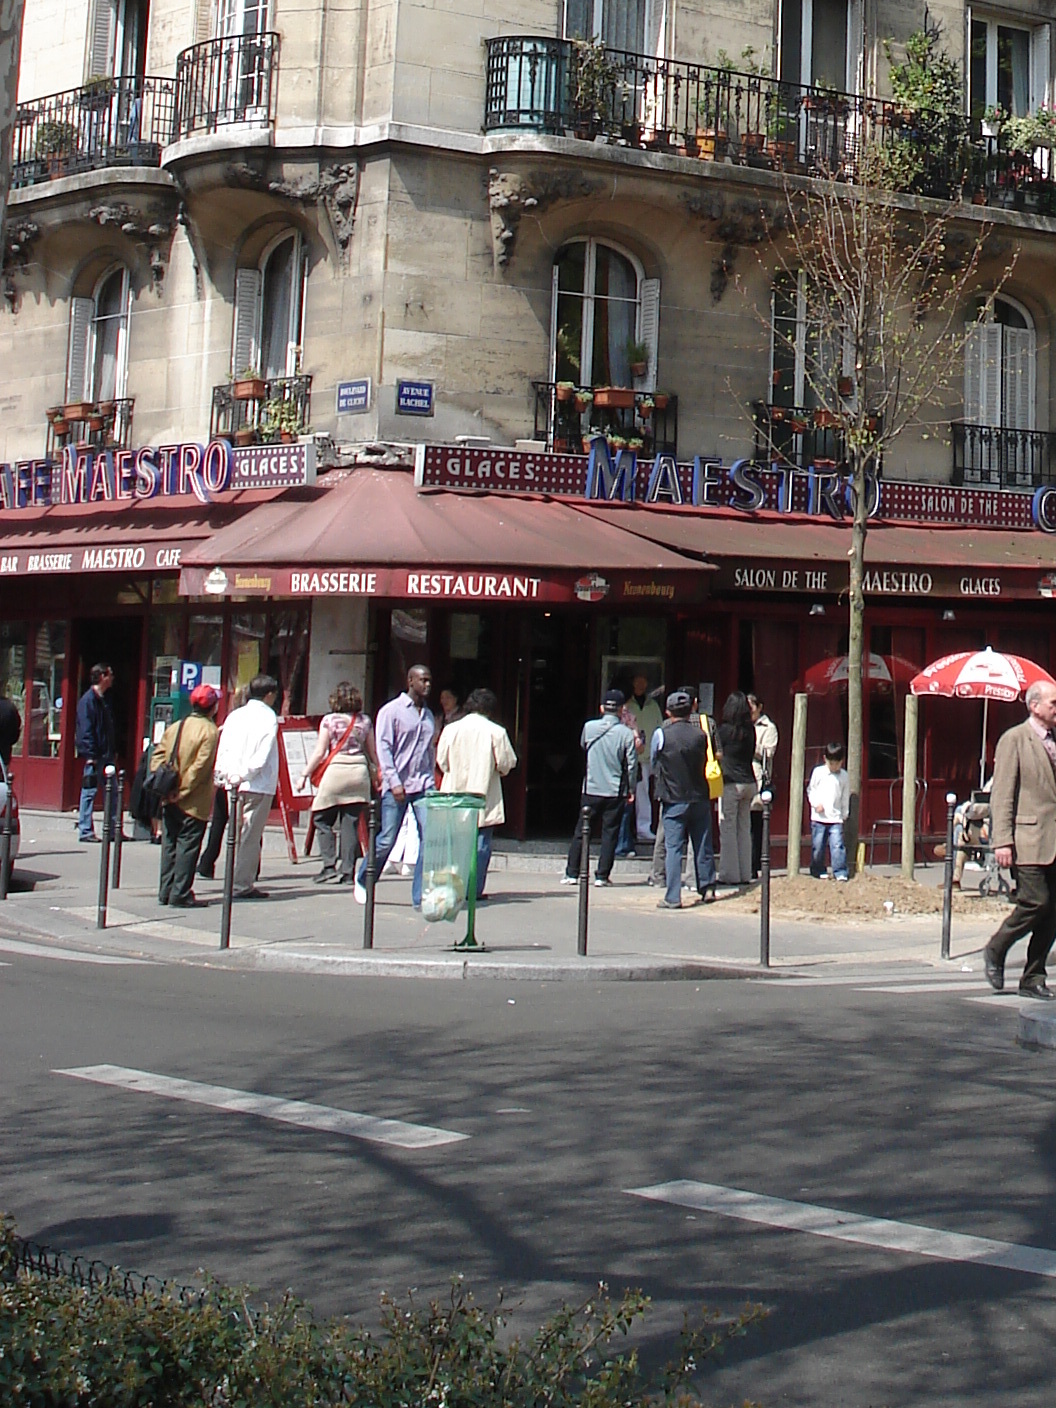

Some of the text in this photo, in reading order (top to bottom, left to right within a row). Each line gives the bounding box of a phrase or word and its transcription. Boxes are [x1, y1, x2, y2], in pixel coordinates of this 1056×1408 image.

[400, 398, 430, 408] RACHEL
[402, 386, 429, 396] AVENUE
[0, 440, 299, 509] AFE MAESTRO GLACES
[446, 460, 536, 481] GLACES
[921, 495, 958, 515] SALON
[961, 497, 976, 515] DE
[979, 497, 1000, 517] THE
[0, 548, 181, 572] BAR BRASSERIE MAESTRO CAFE
[291, 572, 376, 593] BRASSERIE
[407, 574, 541, 598] RESTAURANT
[734, 568, 776, 589] SALON
[782, 570, 799, 589] DE
[804, 571, 827, 590] THE
[960, 577, 1001, 595] GLACES
[182, 663, 198, 685] P
[985, 684, 1015, 698] Pression
